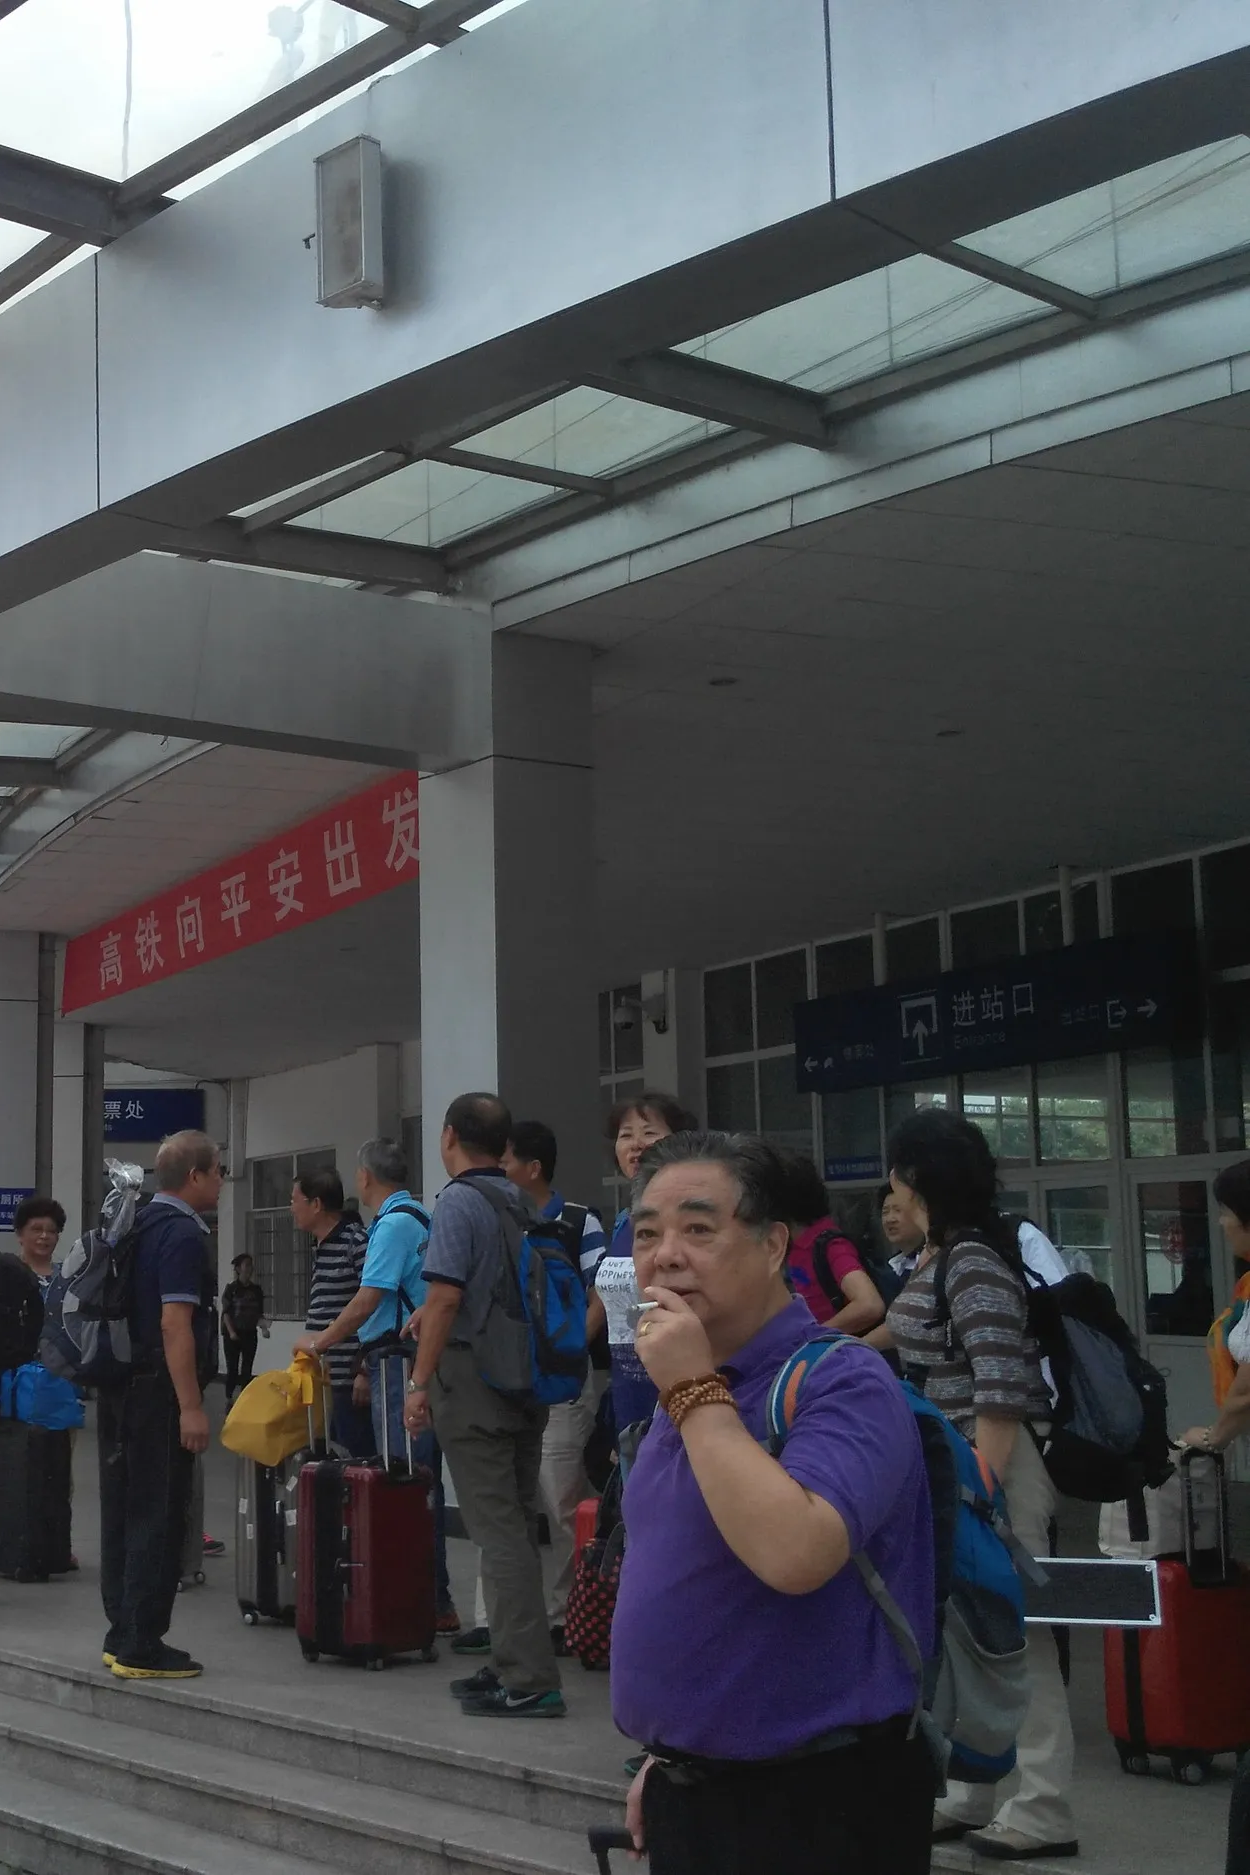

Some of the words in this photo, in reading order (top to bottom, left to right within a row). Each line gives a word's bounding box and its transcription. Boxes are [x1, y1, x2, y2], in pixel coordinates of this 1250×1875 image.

[100, 787, 419, 990] 高铁向平安出发
[951, 982, 1035, 1027] 进站口
[954, 1031, 1007, 1050] Entrance
[103, 1100, 145, 1120] 票处
